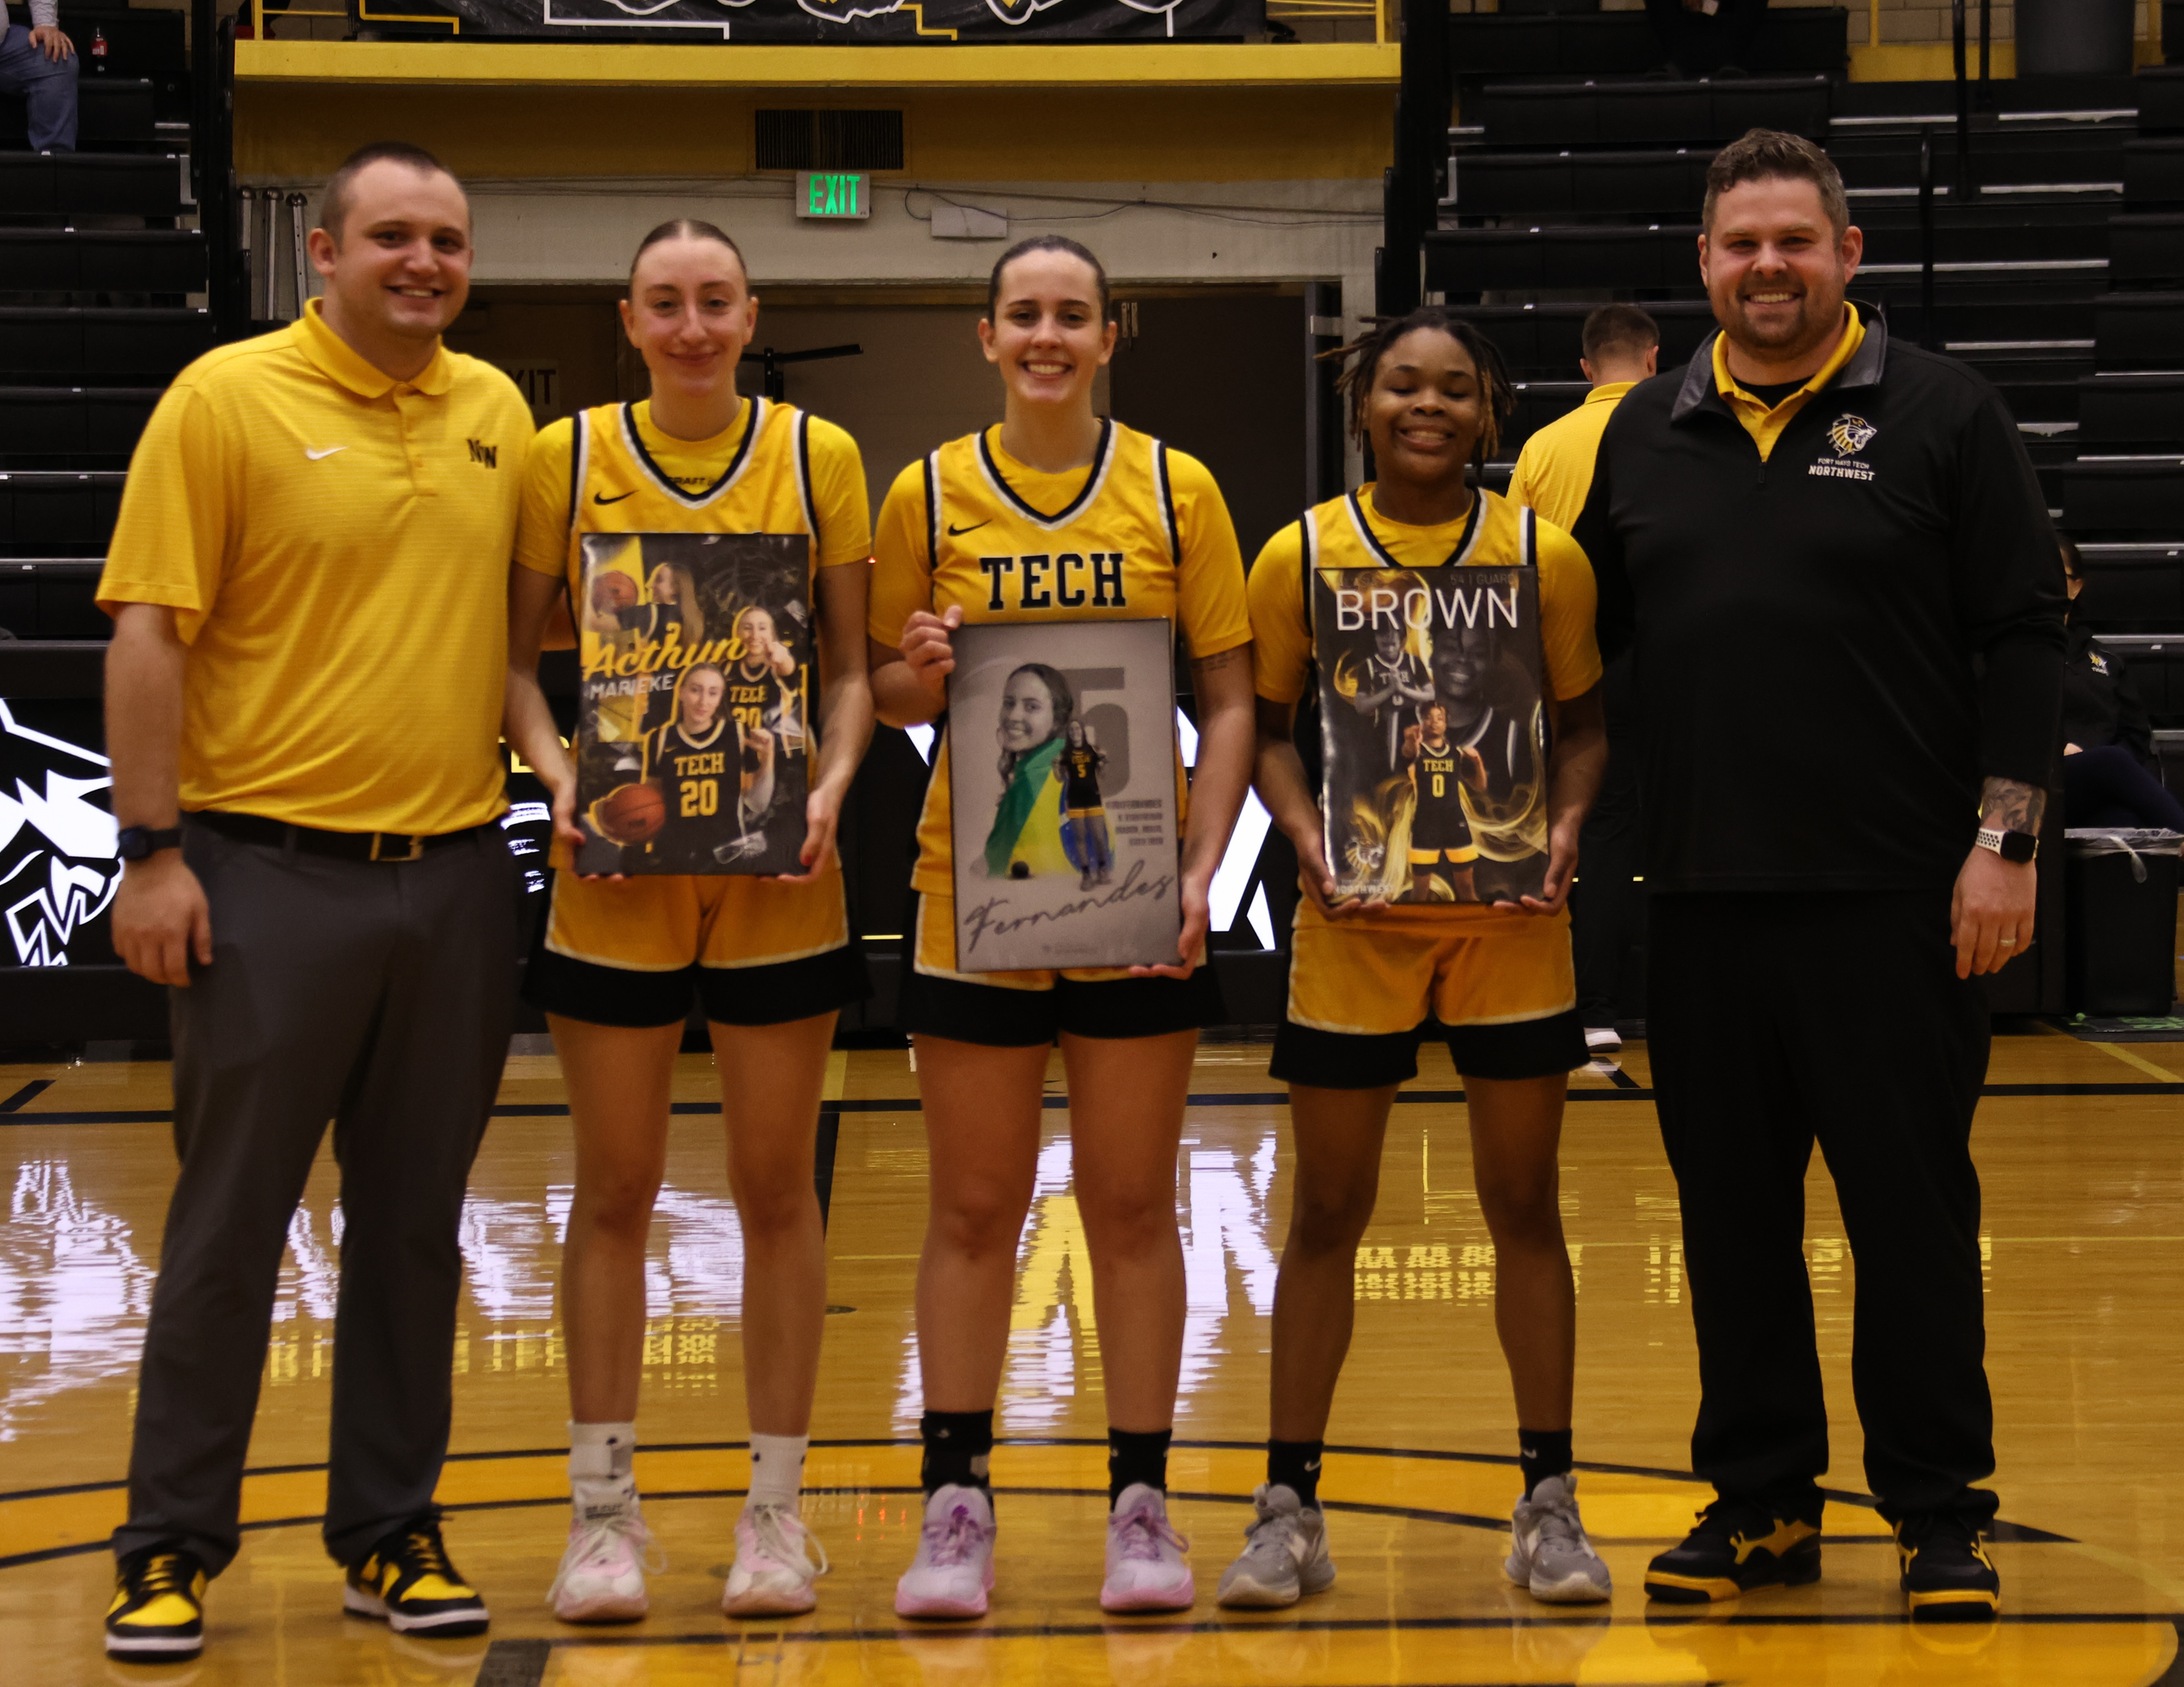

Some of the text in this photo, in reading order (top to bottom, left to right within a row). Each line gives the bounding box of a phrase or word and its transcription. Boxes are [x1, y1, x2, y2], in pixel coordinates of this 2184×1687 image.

[809, 175, 861, 215] EXIT
[1808, 465, 1876, 481] NORTHWEST
[1853, 460, 1871, 470] TECH
[980, 554, 1126, 611] TECH
[1335, 587, 1519, 631] BROWN
[590, 674, 676, 701] MARIEKE
[674, 752, 725, 776] TECH
[1077, 764, 1087, 778] 5
[1423, 759, 1454, 773] TECH
[680, 779, 719, 818] 20
[1432, 774, 1444, 798] 0
[963, 859, 1175, 954] Fernandes
